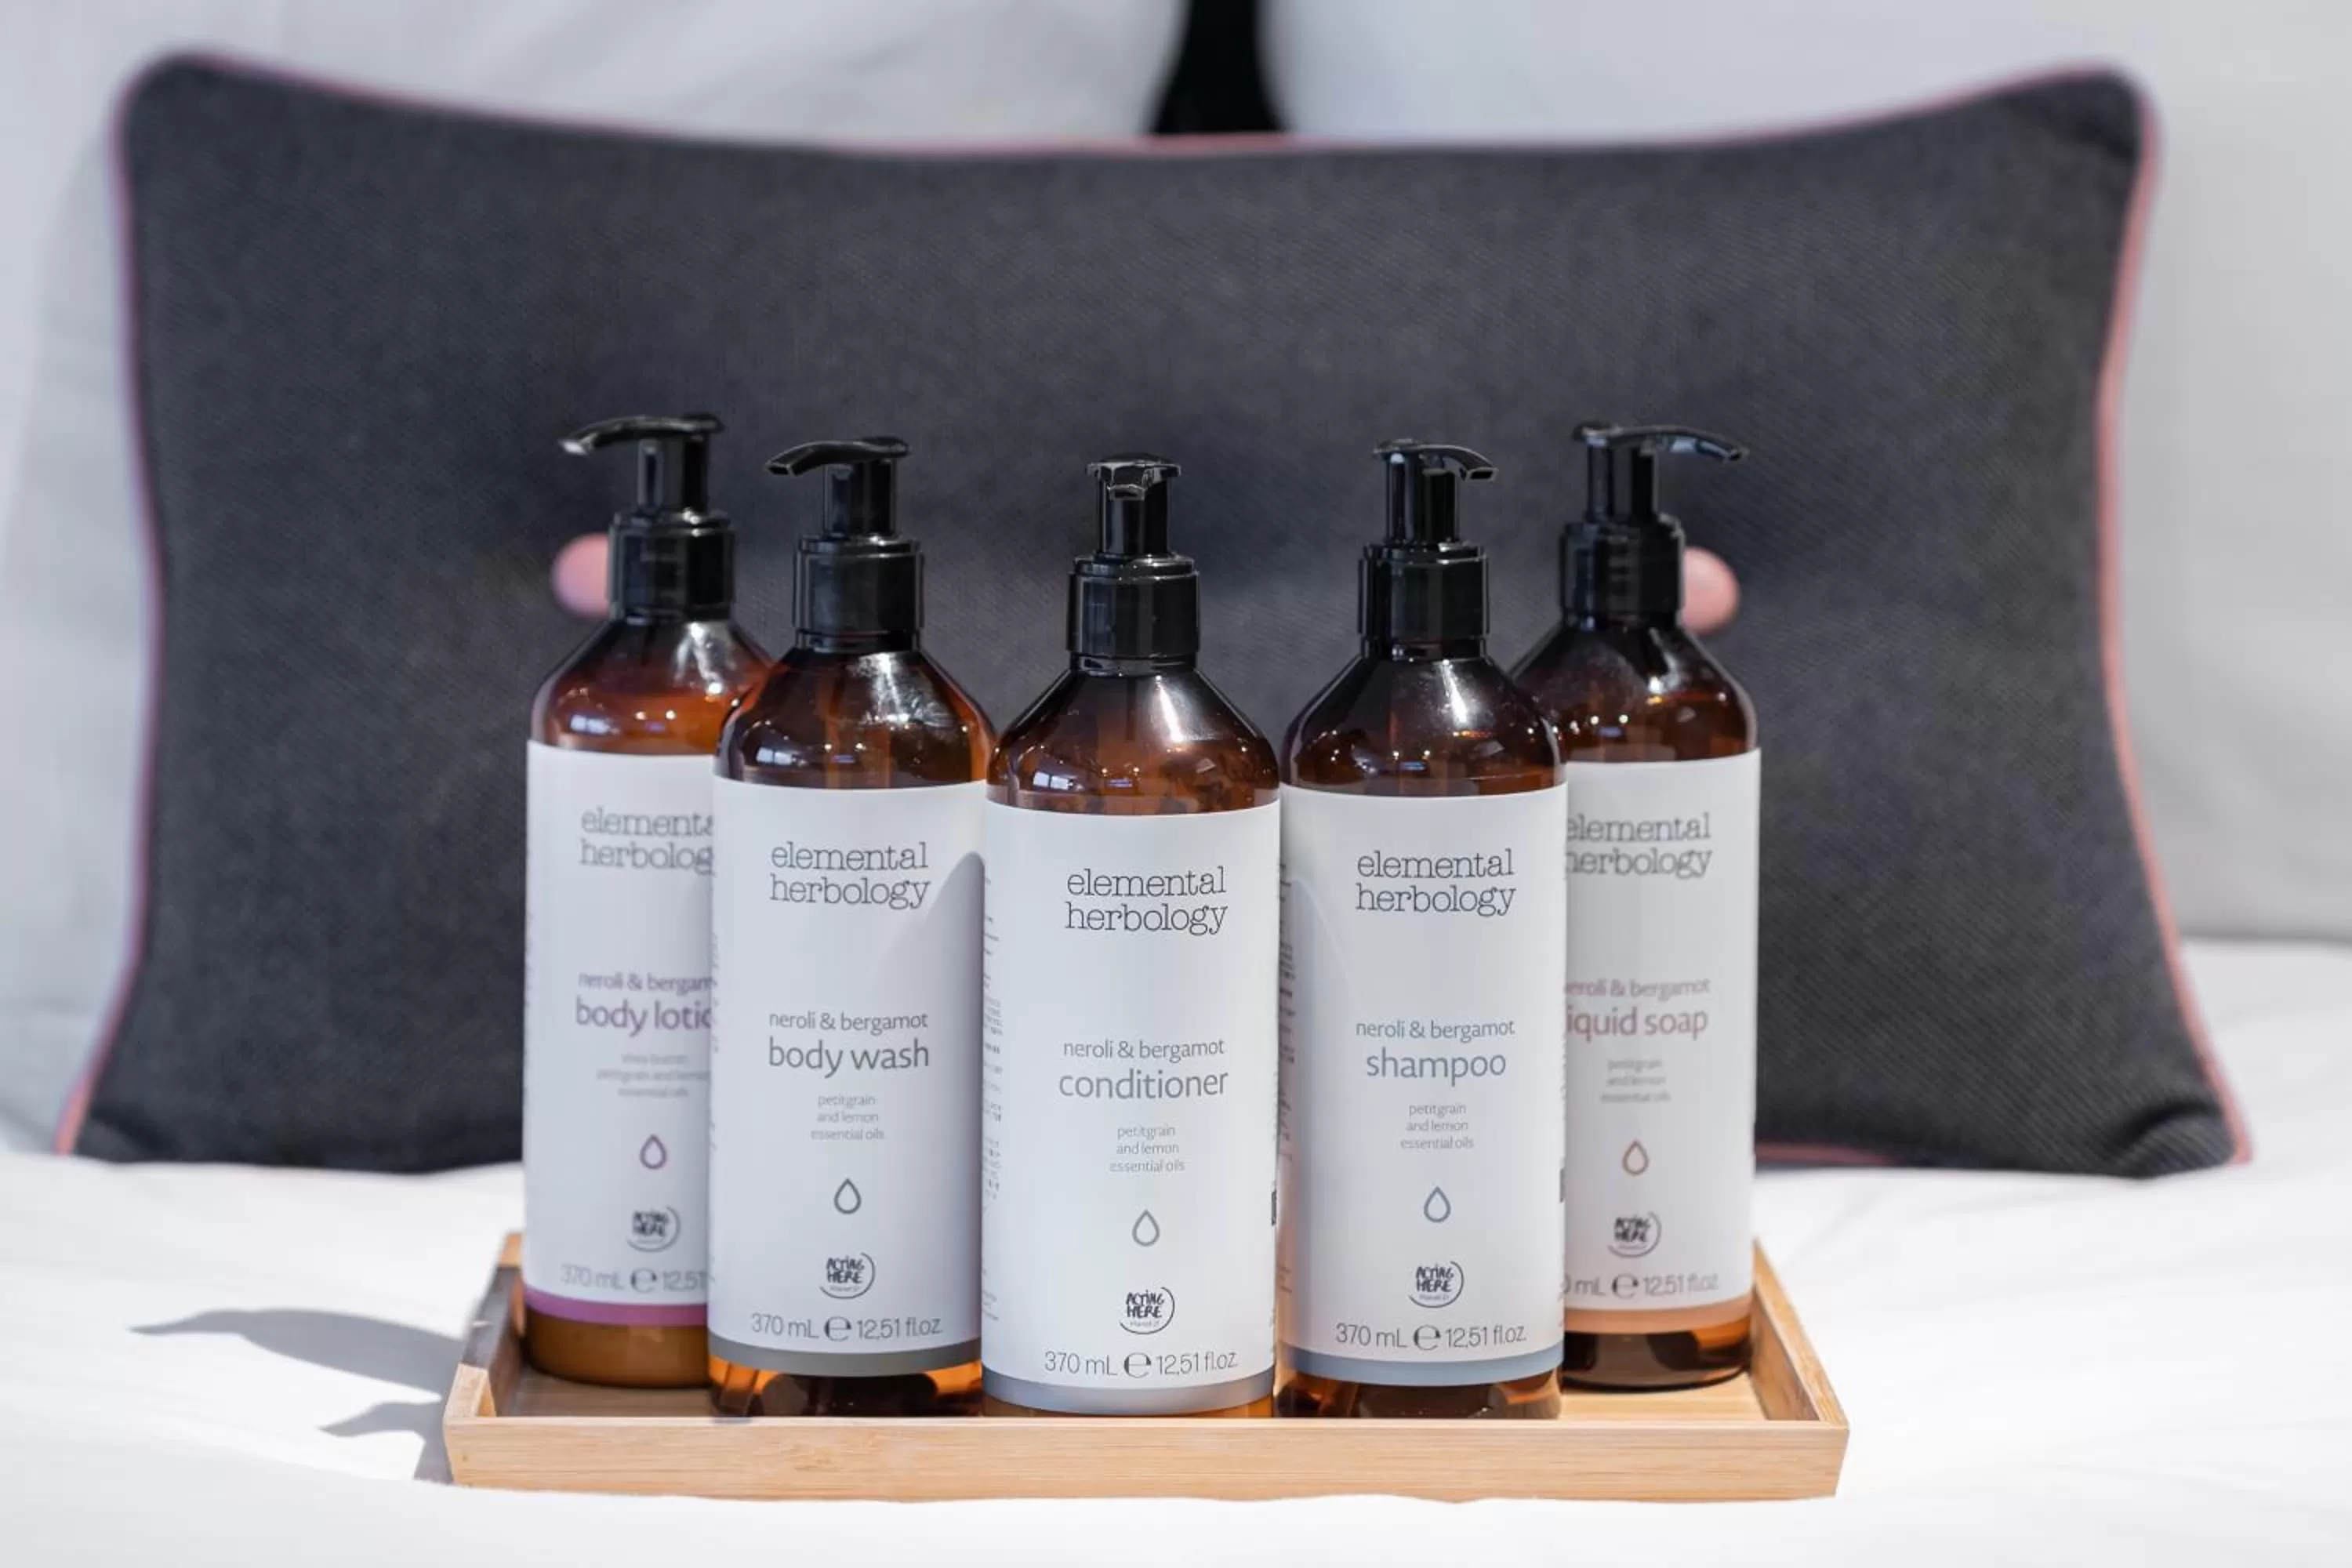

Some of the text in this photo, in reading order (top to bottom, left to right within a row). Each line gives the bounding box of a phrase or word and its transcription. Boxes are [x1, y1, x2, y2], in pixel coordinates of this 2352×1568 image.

[579, 837, 713, 877] herbolog
[771, 840, 929, 871] elemental
[1357, 848, 1515, 878] elemental
[769, 873, 931, 910] herbology
[1066, 866, 1227, 897] elemental
[1356, 883, 1516, 917] herbology
[1065, 902, 1229, 936] herbology
[627, 973, 643, 991] &
[575, 994, 648, 1038] body
[769, 1011, 929, 1036] neroli & bergamot
[1566, 1004, 1709, 1044] iquid soap
[1356, 1019, 1515, 1044] neroli & bergamot
[768, 1035, 930, 1079] body wash
[1063, 1038, 1225, 1063] neroli & bergamot
[1367, 1046, 1506, 1087] shampoo
[1059, 1068, 1229, 1099] conditioner
[817, 1112, 839, 1123] and
[1408, 1103, 1467, 1118] petitgrain
[1117, 1123, 1176, 1140] petitgrain
[1406, 1120, 1468, 1131] and lemon
[1116, 1142, 1180, 1155] and lemon
[1400, 1136, 1474, 1149] essential oils
[1109, 1160, 1185, 1173] essential oils
[1127, 1305, 1162, 1319] HERE
[751, 1312, 783, 1335] 370
[788, 1319, 819, 1339] mL
[1335, 1323, 1371, 1346] 370
[1376, 1328, 1407, 1348] mL
[1044, 1351, 1080, 1374] 370
[1086, 1355, 1117, 1376] mL
